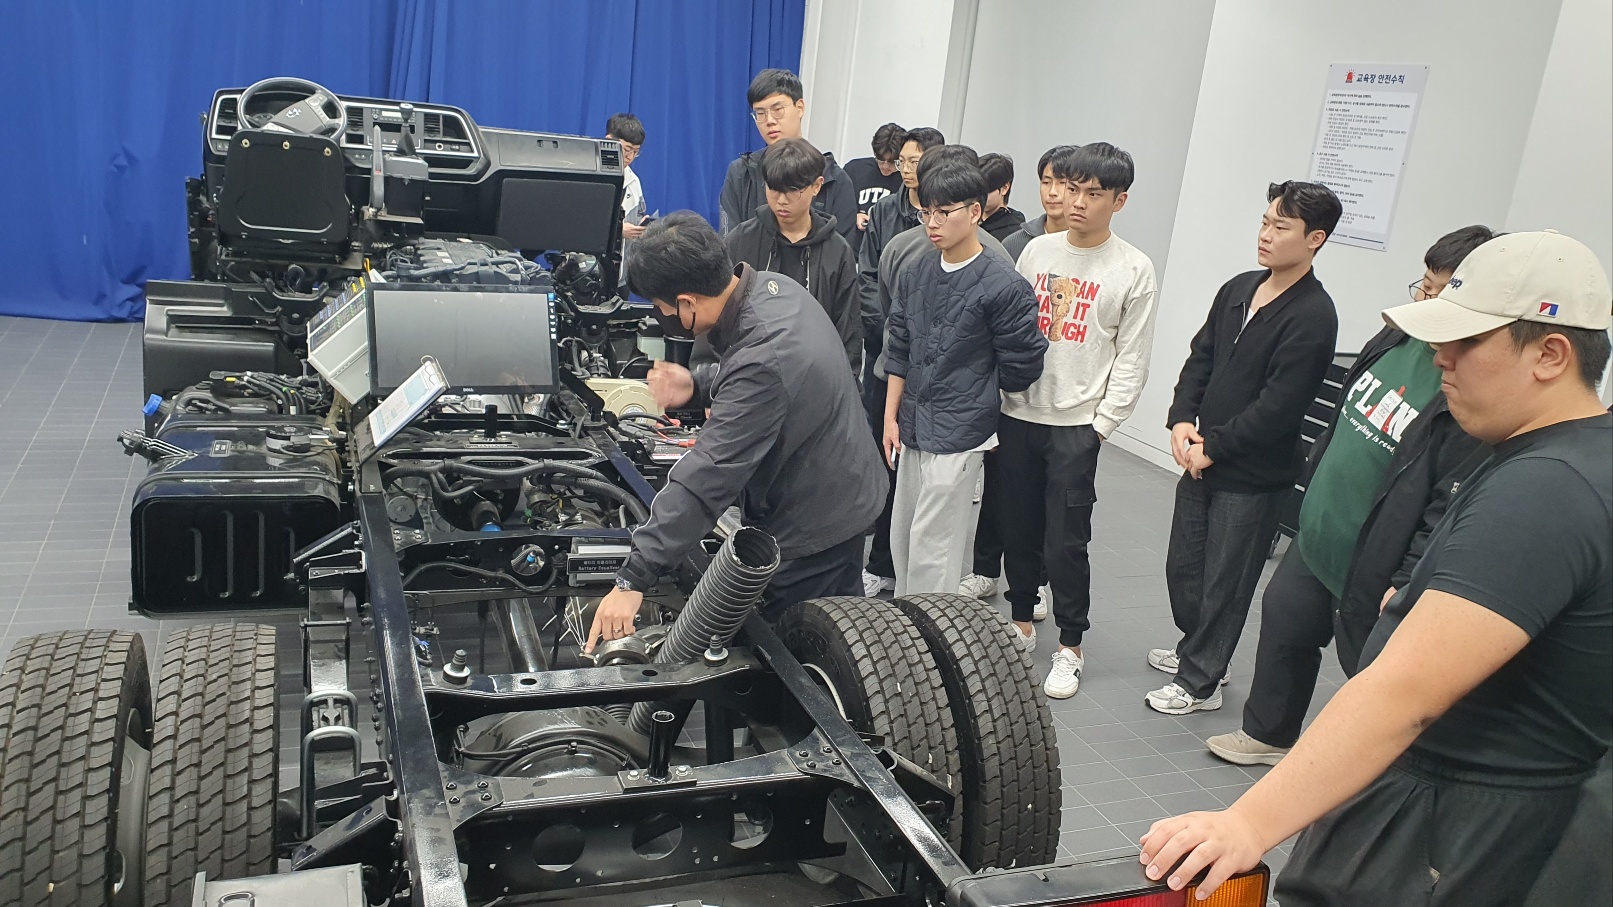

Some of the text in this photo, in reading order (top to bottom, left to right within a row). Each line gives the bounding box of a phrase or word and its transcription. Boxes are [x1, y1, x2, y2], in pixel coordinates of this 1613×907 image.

[1356, 73, 1405, 84] 교육장 안전수칙
[1072, 301, 1090, 322] IT
